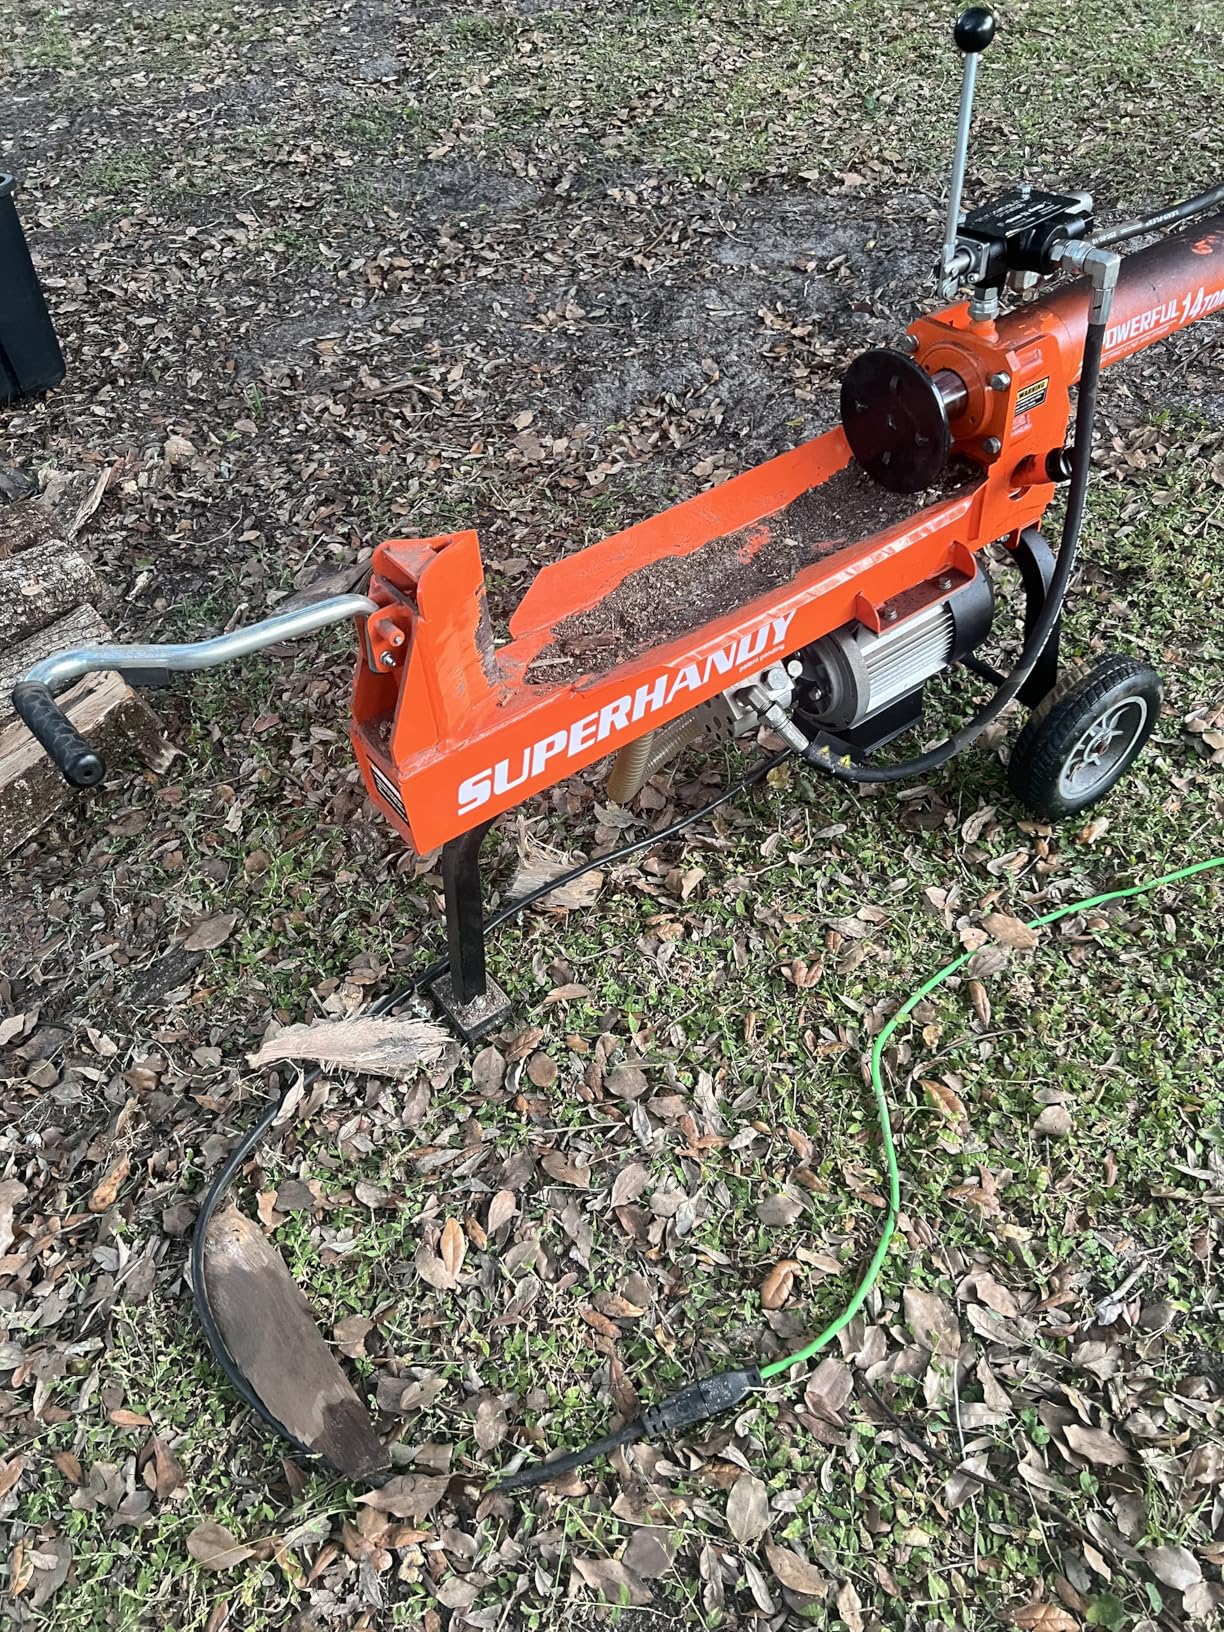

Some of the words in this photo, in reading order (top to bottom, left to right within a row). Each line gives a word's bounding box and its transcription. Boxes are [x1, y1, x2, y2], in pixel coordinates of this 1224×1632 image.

[1103, 299, 1180, 349] OWERFUL
[1179, 287, 1205, 324] 14
[457, 609, 797, 816] SUPERHANDY
